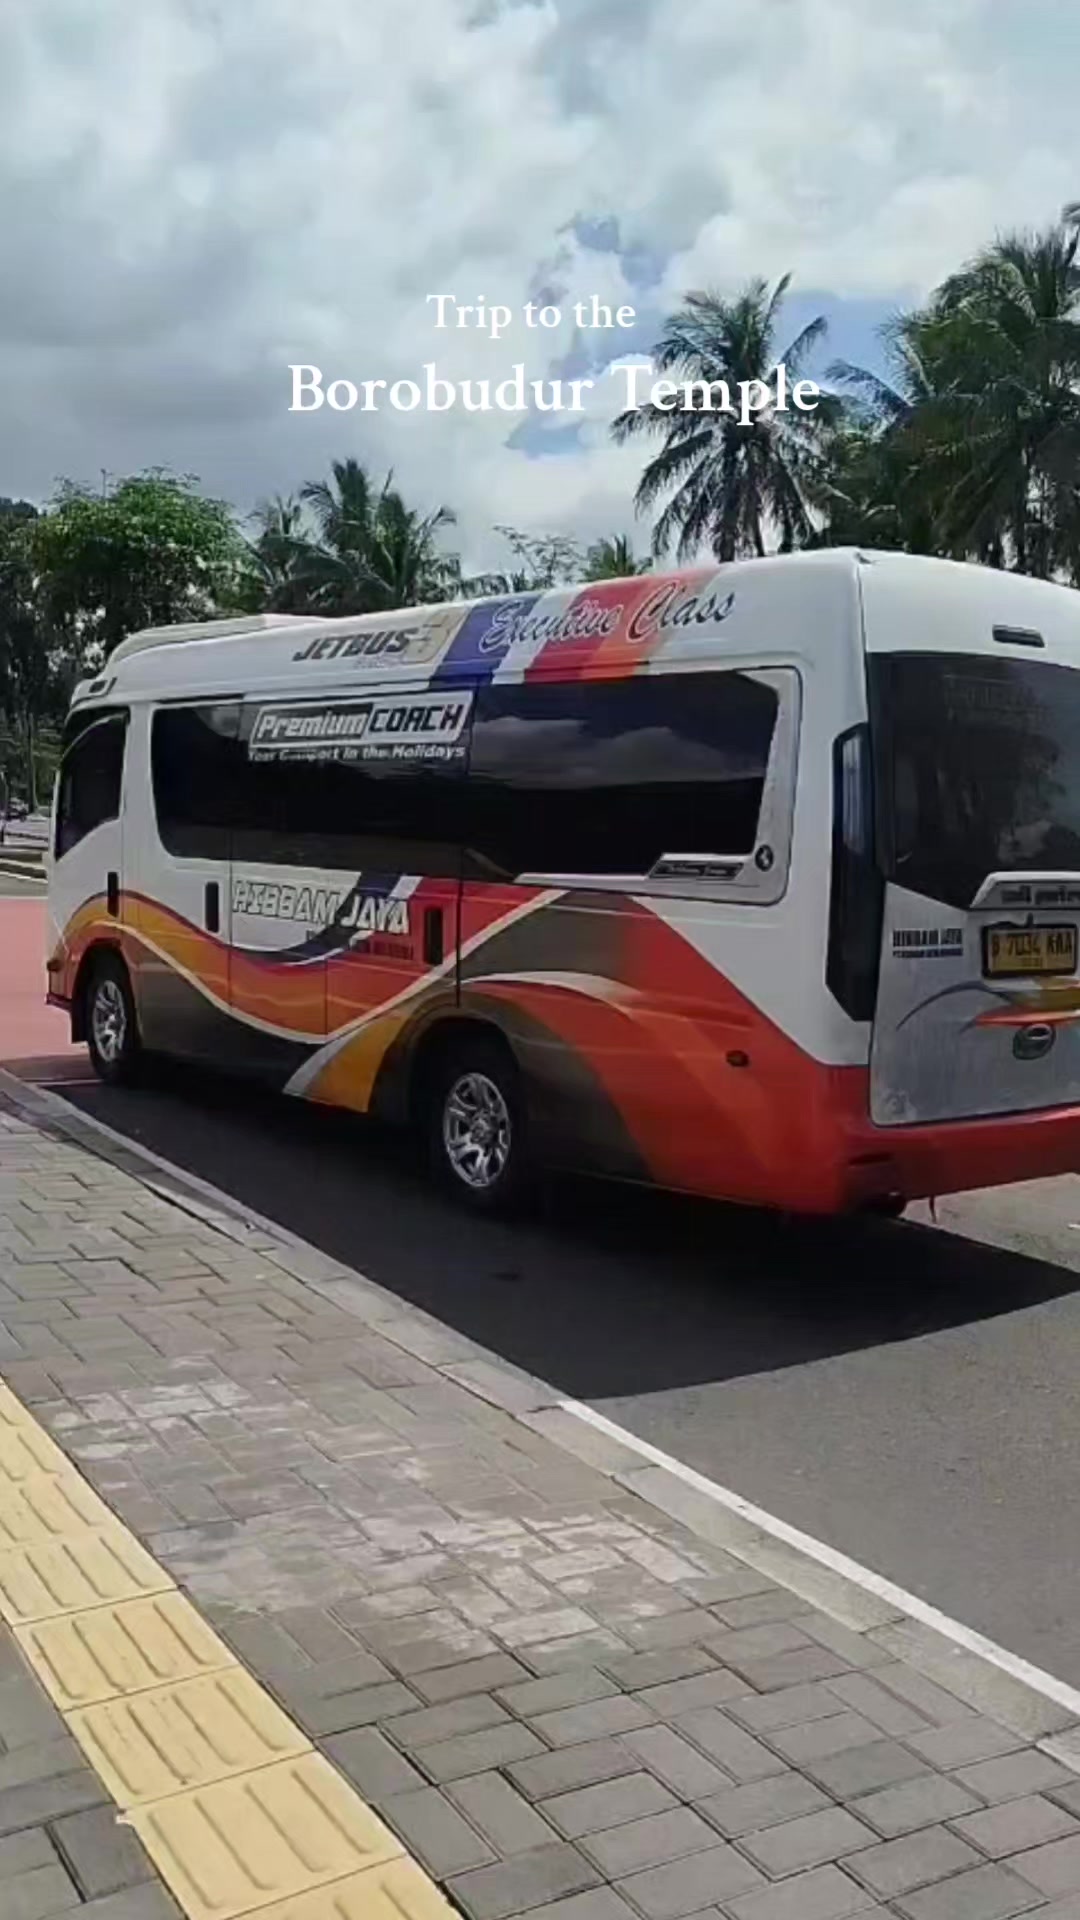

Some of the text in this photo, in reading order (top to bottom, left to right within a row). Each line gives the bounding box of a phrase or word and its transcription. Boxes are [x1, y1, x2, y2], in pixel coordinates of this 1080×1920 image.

[479, 582, 736, 653] Executive Class
[292, 627, 419, 662] JETBUS
[256, 704, 465, 739] Premium COACH
[392, 743, 466, 760] Holidays
[340, 894, 410, 934] JAYA
